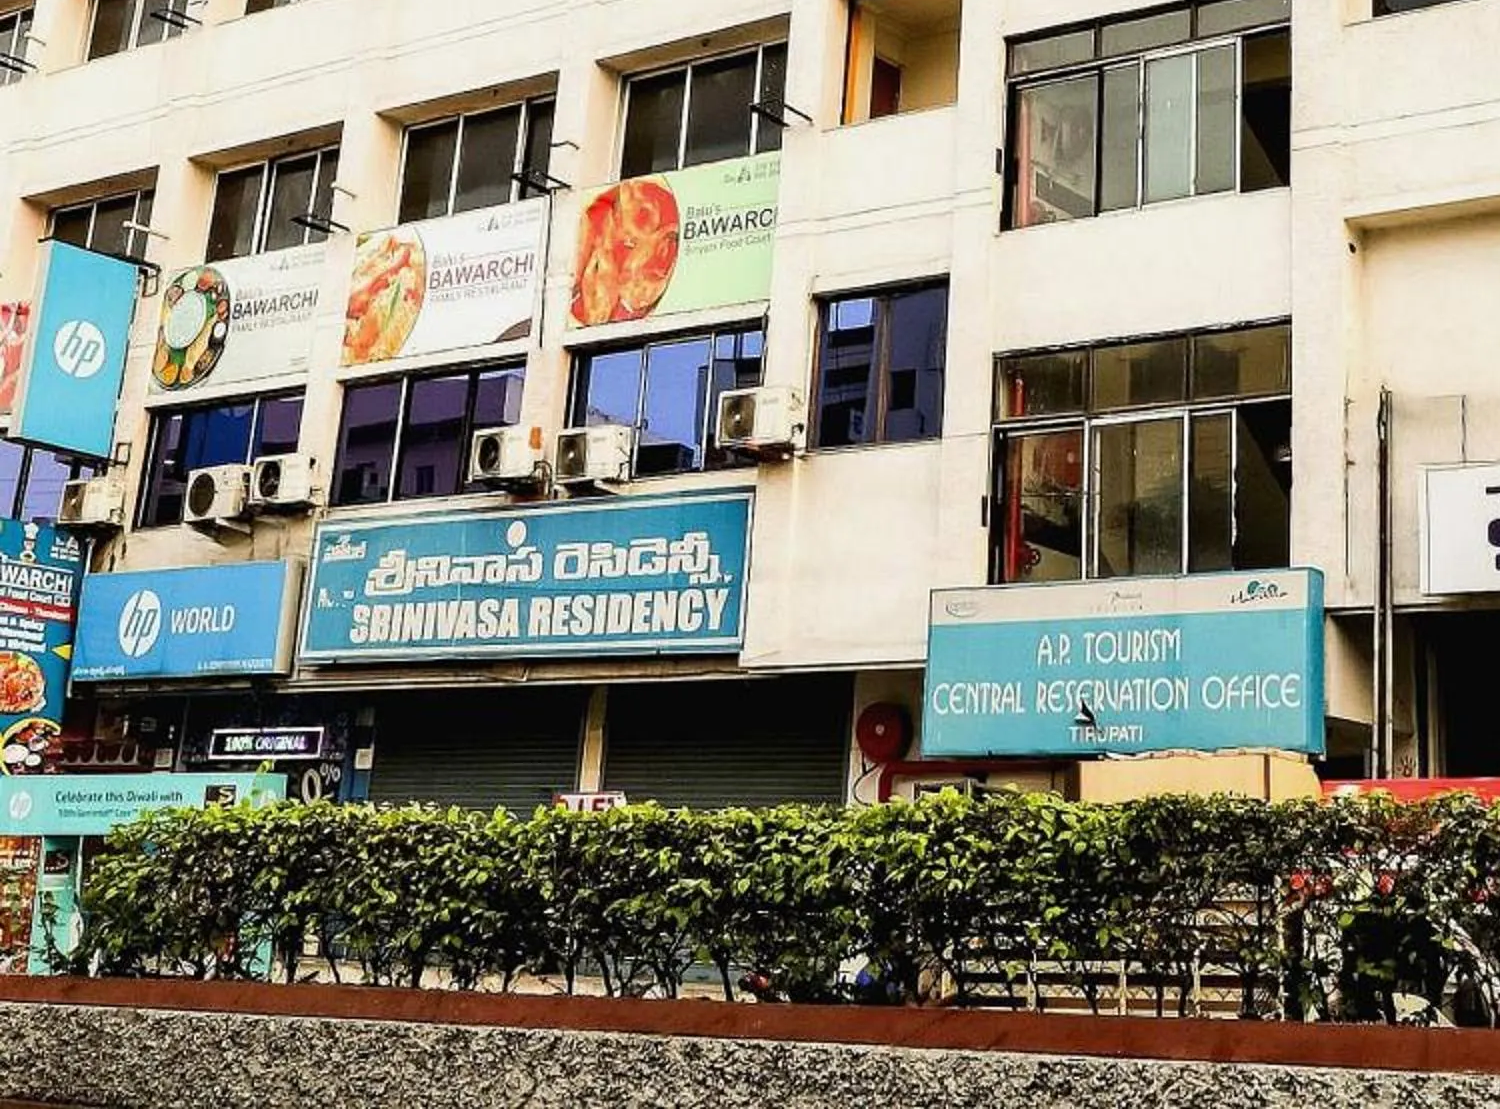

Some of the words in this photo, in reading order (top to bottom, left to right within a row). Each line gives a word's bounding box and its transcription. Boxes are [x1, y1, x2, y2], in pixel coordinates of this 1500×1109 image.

[684, 207, 778, 240] BAWARC
[429, 252, 535, 290] BAWARCHI
[231, 288, 319, 320] BAWARCHI
[53, 320, 106, 378] hp
[119, 589, 161, 659] hp
[171, 603, 236, 635] WORLD
[350, 597, 520, 644] SRINIVASA
[528, 587, 730, 637] RESIDENCY
[1037, 633, 1071, 668] A.P.
[1083, 628, 1181, 665] TOURISM
[932, 681, 1025, 716] CENTRAL
[1036, 676, 1190, 714] RESERVATION
[1201, 673, 1301, 711] OFFICE
[1068, 724, 1143, 743] TIRUPATI
[55, 790, 103, 804] Celebrate
[105, 790, 125, 802] this
[126, 790, 158, 802] Diwali
